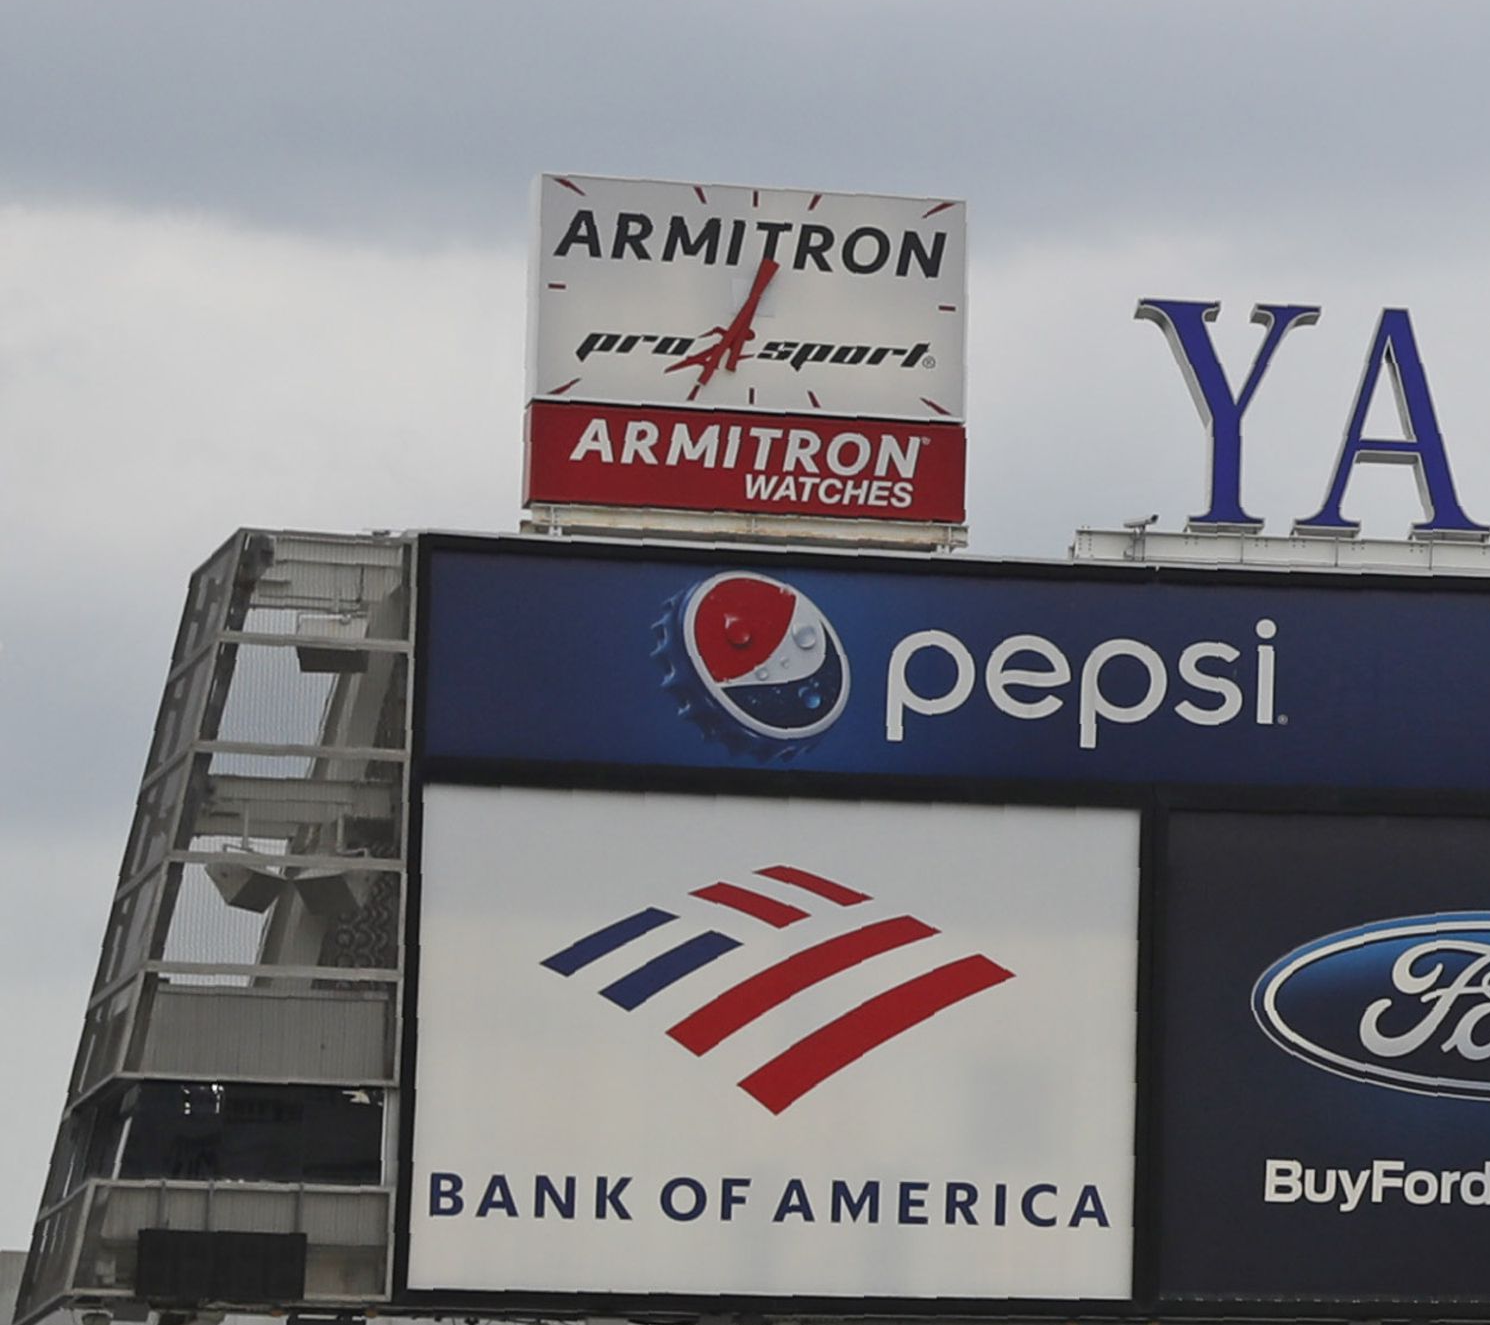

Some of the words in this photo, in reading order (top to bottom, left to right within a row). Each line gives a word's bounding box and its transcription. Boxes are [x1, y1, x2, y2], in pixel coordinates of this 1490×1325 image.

[554, 209, 947, 278] ARMITRON
[575, 330, 697, 363] pro
[756, 338, 931, 372] sport
[570, 419, 920, 478] ARMITRON
[746, 469, 914, 507] WATCHES
[886, 619, 1276, 748] pepsi
[430, 1173, 632, 1220] BANK
[660, 1178, 751, 1221] OF
[773, 1179, 1109, 1227] AMERICA
